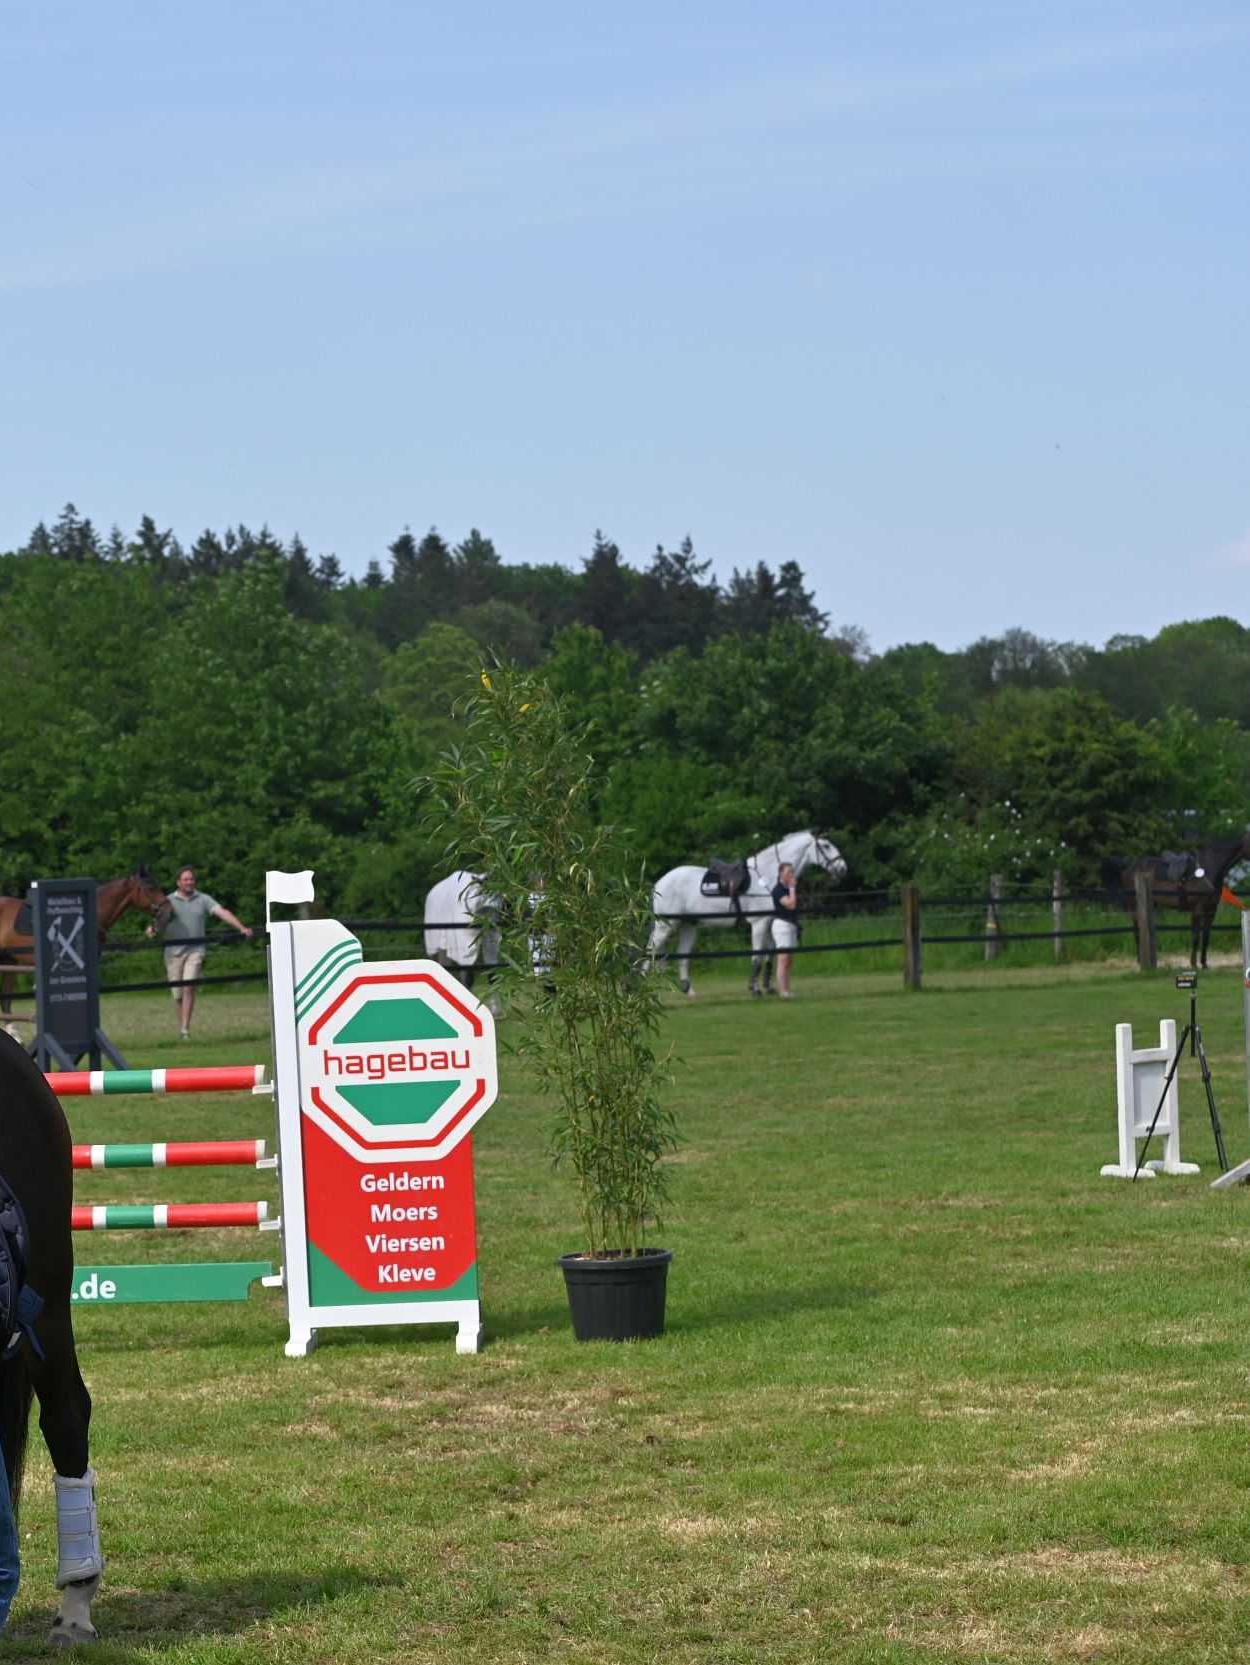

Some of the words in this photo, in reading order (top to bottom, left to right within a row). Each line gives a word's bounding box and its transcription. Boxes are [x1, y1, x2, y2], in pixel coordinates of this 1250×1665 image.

[324, 1045, 470, 1080] hagebau
[360, 1172, 445, 1194] Geldern
[370, 1203, 438, 1223] Moers
[365, 1233, 445, 1254] Viersen
[377, 1264, 437, 1284] Kleve
